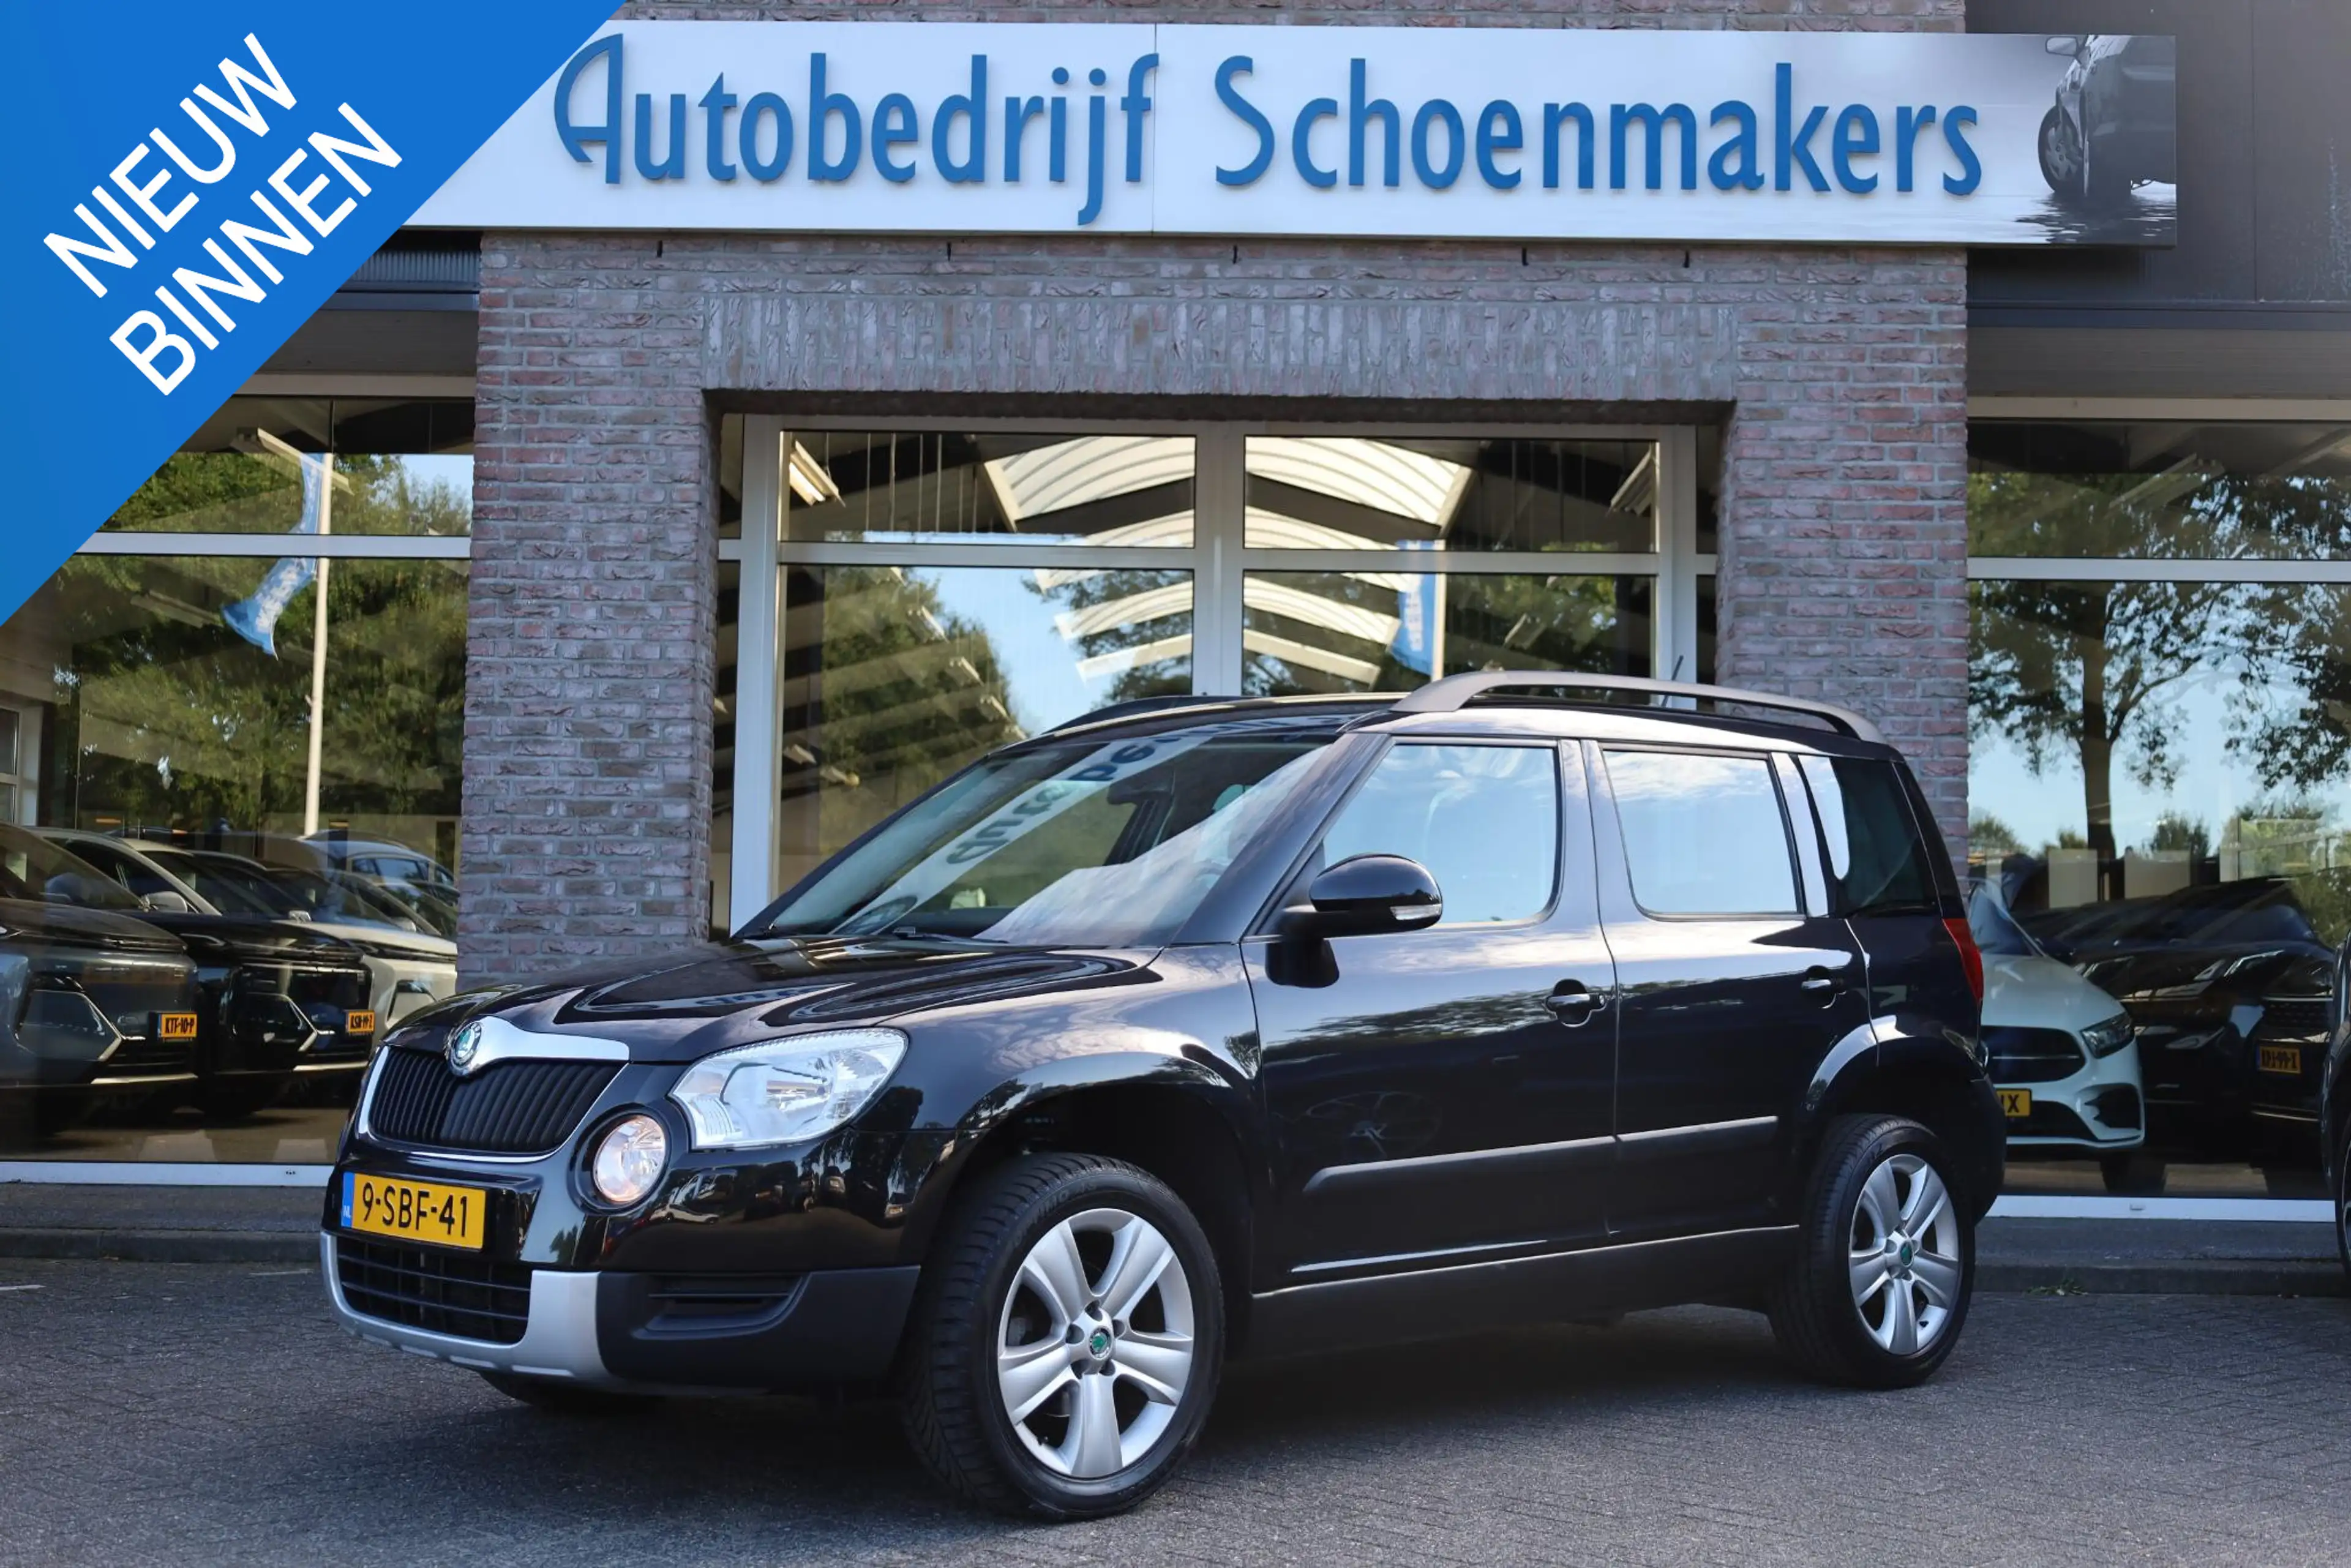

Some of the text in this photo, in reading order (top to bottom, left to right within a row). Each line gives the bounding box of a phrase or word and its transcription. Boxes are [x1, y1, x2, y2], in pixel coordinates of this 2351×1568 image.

[554, 33, 1981, 225] Autobedrijf Schoenmakers
[362, 1182, 468, 1237] 9-SBF-41
